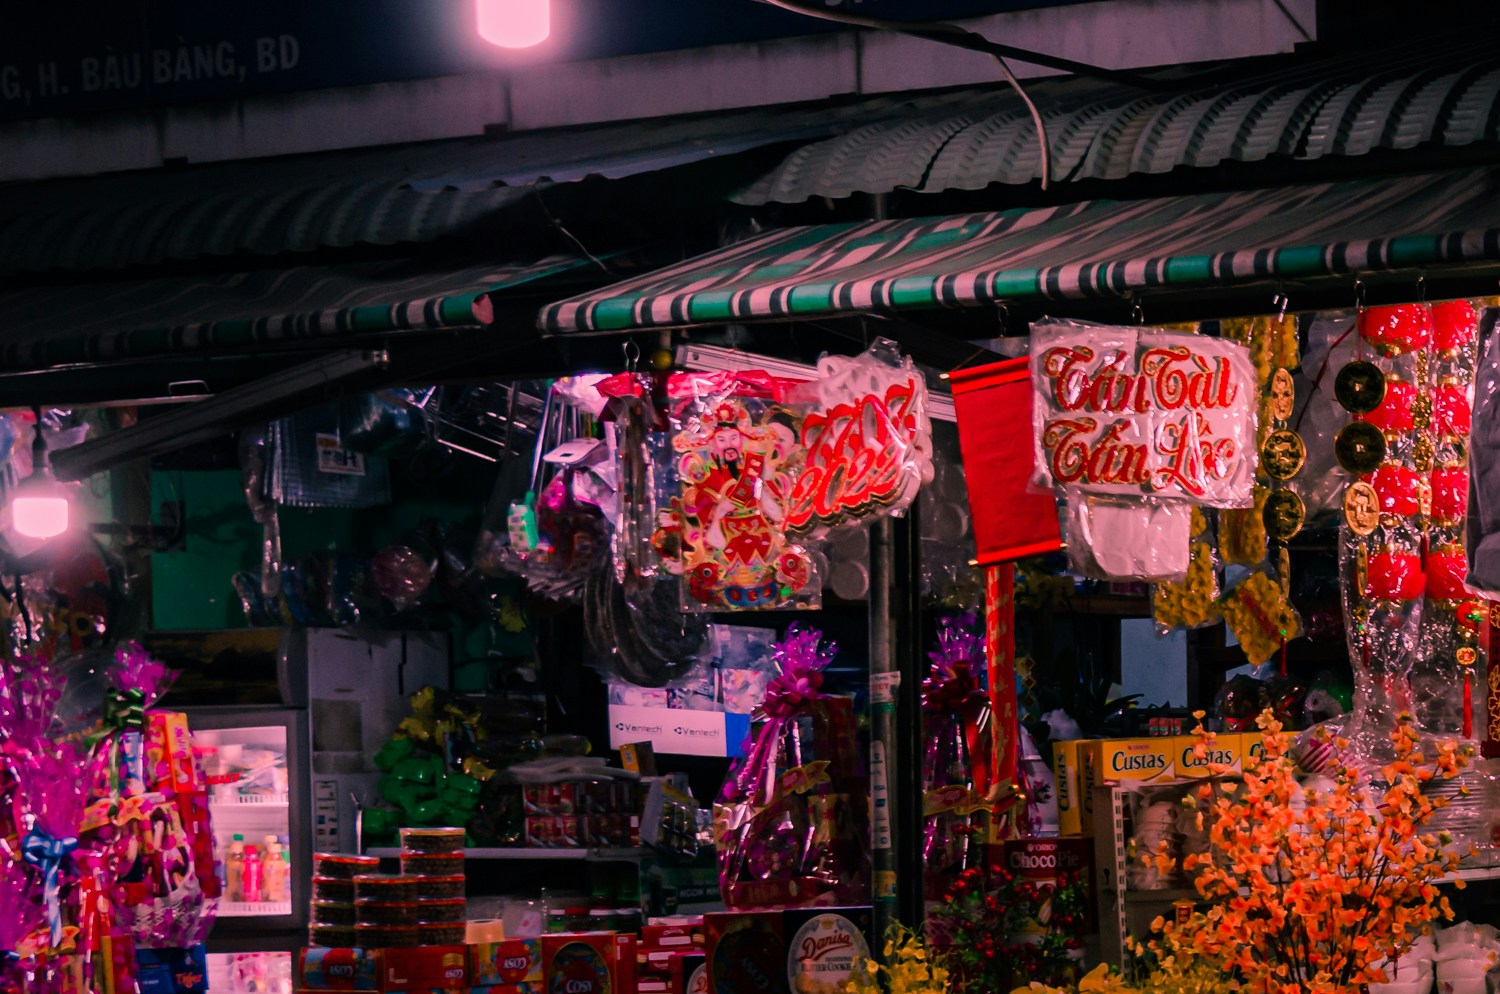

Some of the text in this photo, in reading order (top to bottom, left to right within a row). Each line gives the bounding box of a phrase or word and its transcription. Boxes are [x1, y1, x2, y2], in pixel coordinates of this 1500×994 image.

[37, 60, 70, 97] H.
[80, 44, 142, 93] BÀU
[152, 34, 248, 85] BÀNG,
[256, 33, 300, 73] BD
[1043, 416, 1150, 484] Tấn
[624, 722, 663, 734] Vantech
[682, 727, 720, 738] Vantech
[1112, 751, 1166, 772] Custas
[1008, 850, 1057, 869] Choco
[798, 929, 854, 962] Danisa
[503, 956, 528, 970] COSY
[174, 972, 204, 990] Tiger
[565, 979, 595, 994] COSY
